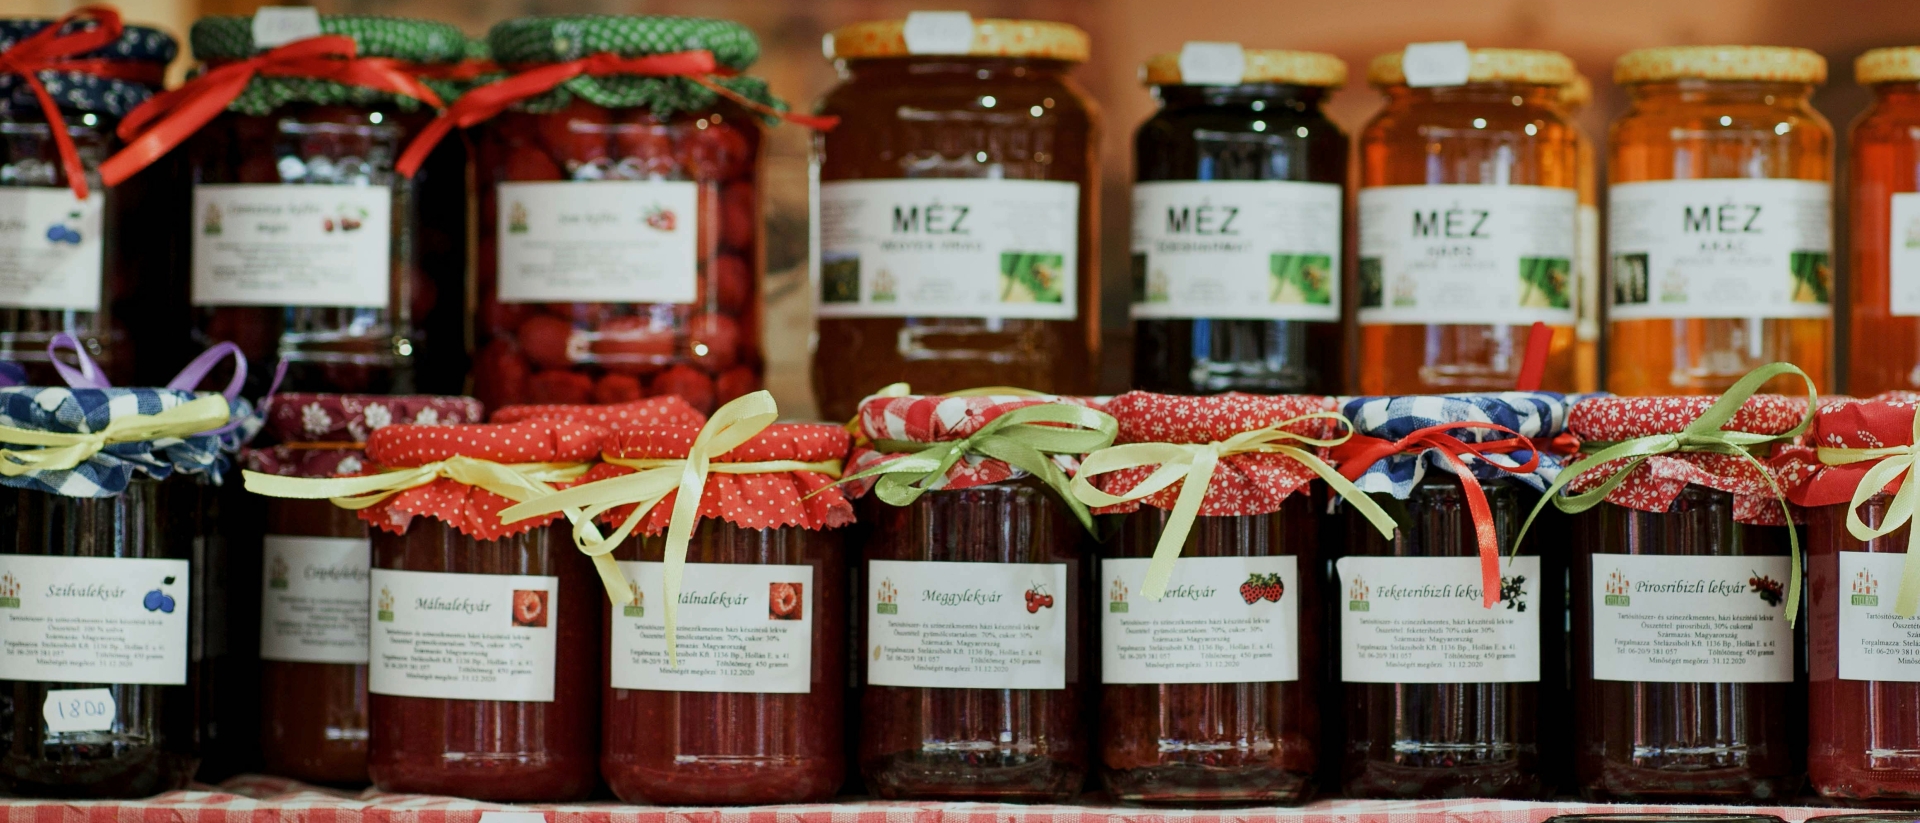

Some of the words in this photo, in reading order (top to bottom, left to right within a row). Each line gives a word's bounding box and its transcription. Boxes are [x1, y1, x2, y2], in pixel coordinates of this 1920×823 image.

[892, 197, 970, 235] MÉZ
[1166, 197, 1240, 235] MÉZ
[1413, 201, 1490, 238] MÉZ
[1684, 197, 1763, 233] MÉZ
[45, 582, 126, 601] Szilvalekvár
[922, 588, 1003, 606] Meggylekvár
[1376, 584, 1452, 601] Feketeribizli
[1634, 579, 1706, 593] Pirosribizli
[1708, 579, 1746, 597] lekvár
[414, 596, 492, 614] Málnalekvár
[956, 640, 1000, 649] Magyarország
[1429, 636, 1474, 644] Magyarország
[1694, 632, 1738, 641] Magyarország
